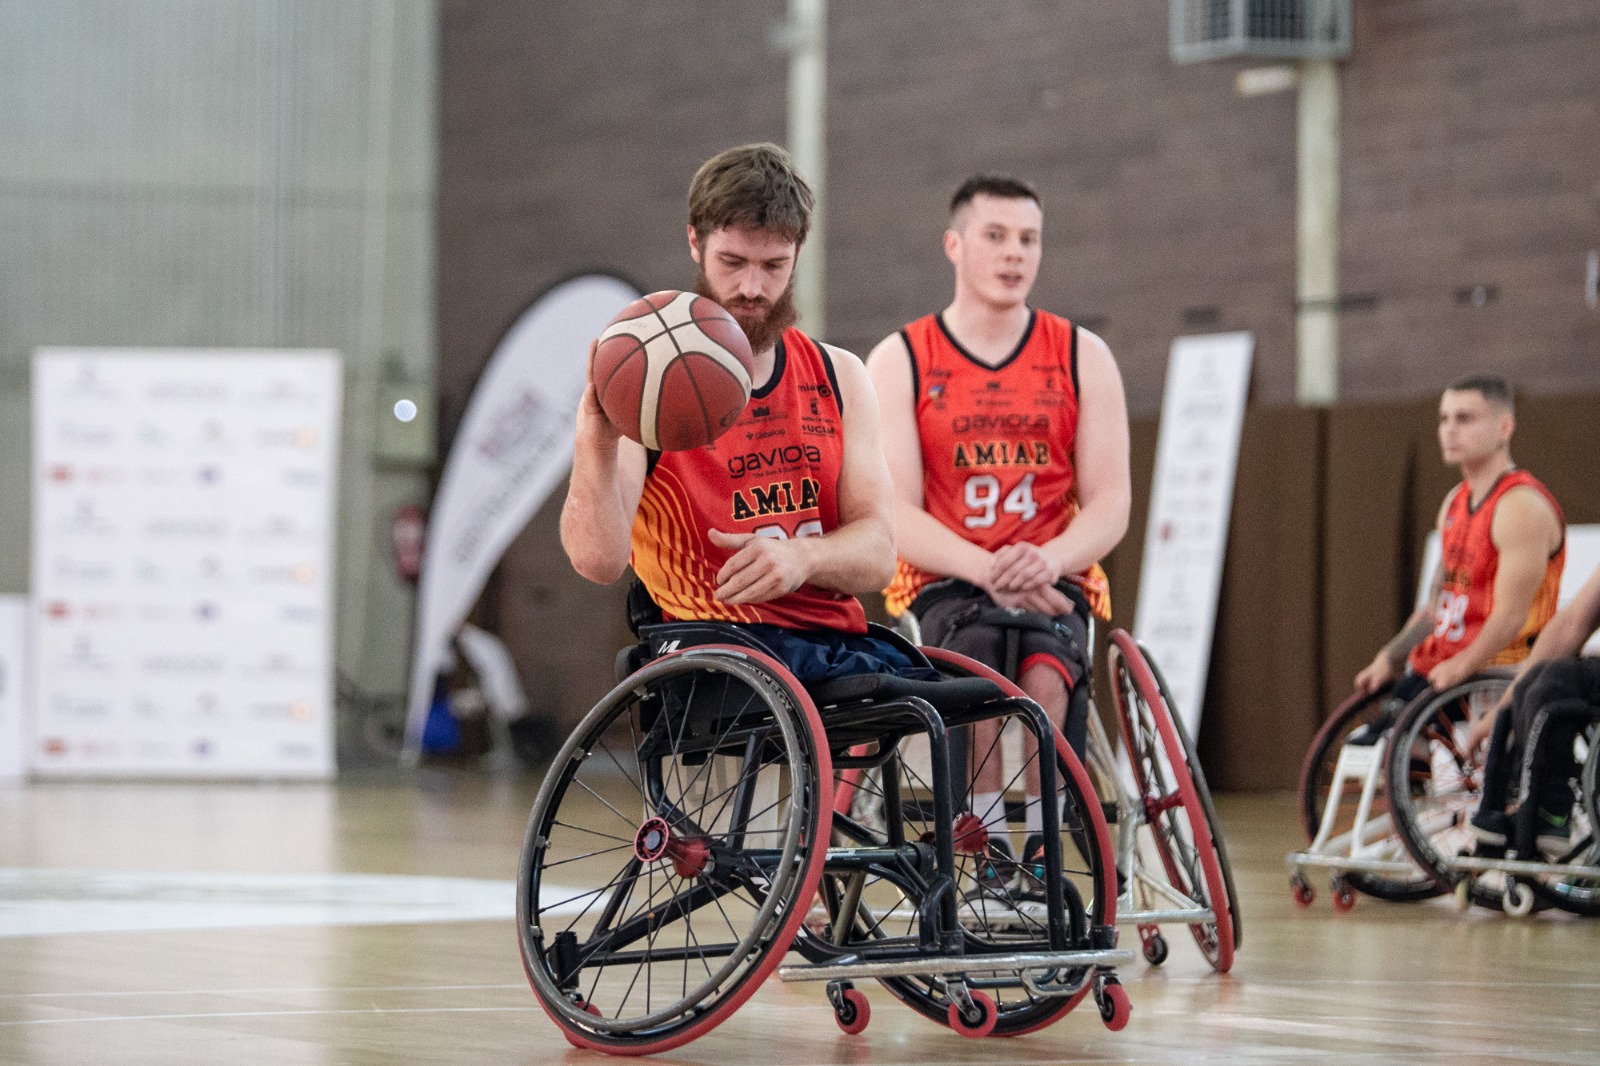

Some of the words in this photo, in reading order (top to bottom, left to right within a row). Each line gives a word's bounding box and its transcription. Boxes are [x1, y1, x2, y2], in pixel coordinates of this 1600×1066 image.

[953, 439, 1050, 468] AMIAB
[731, 477, 821, 521] AMIA
[964, 472, 1039, 529] 94
